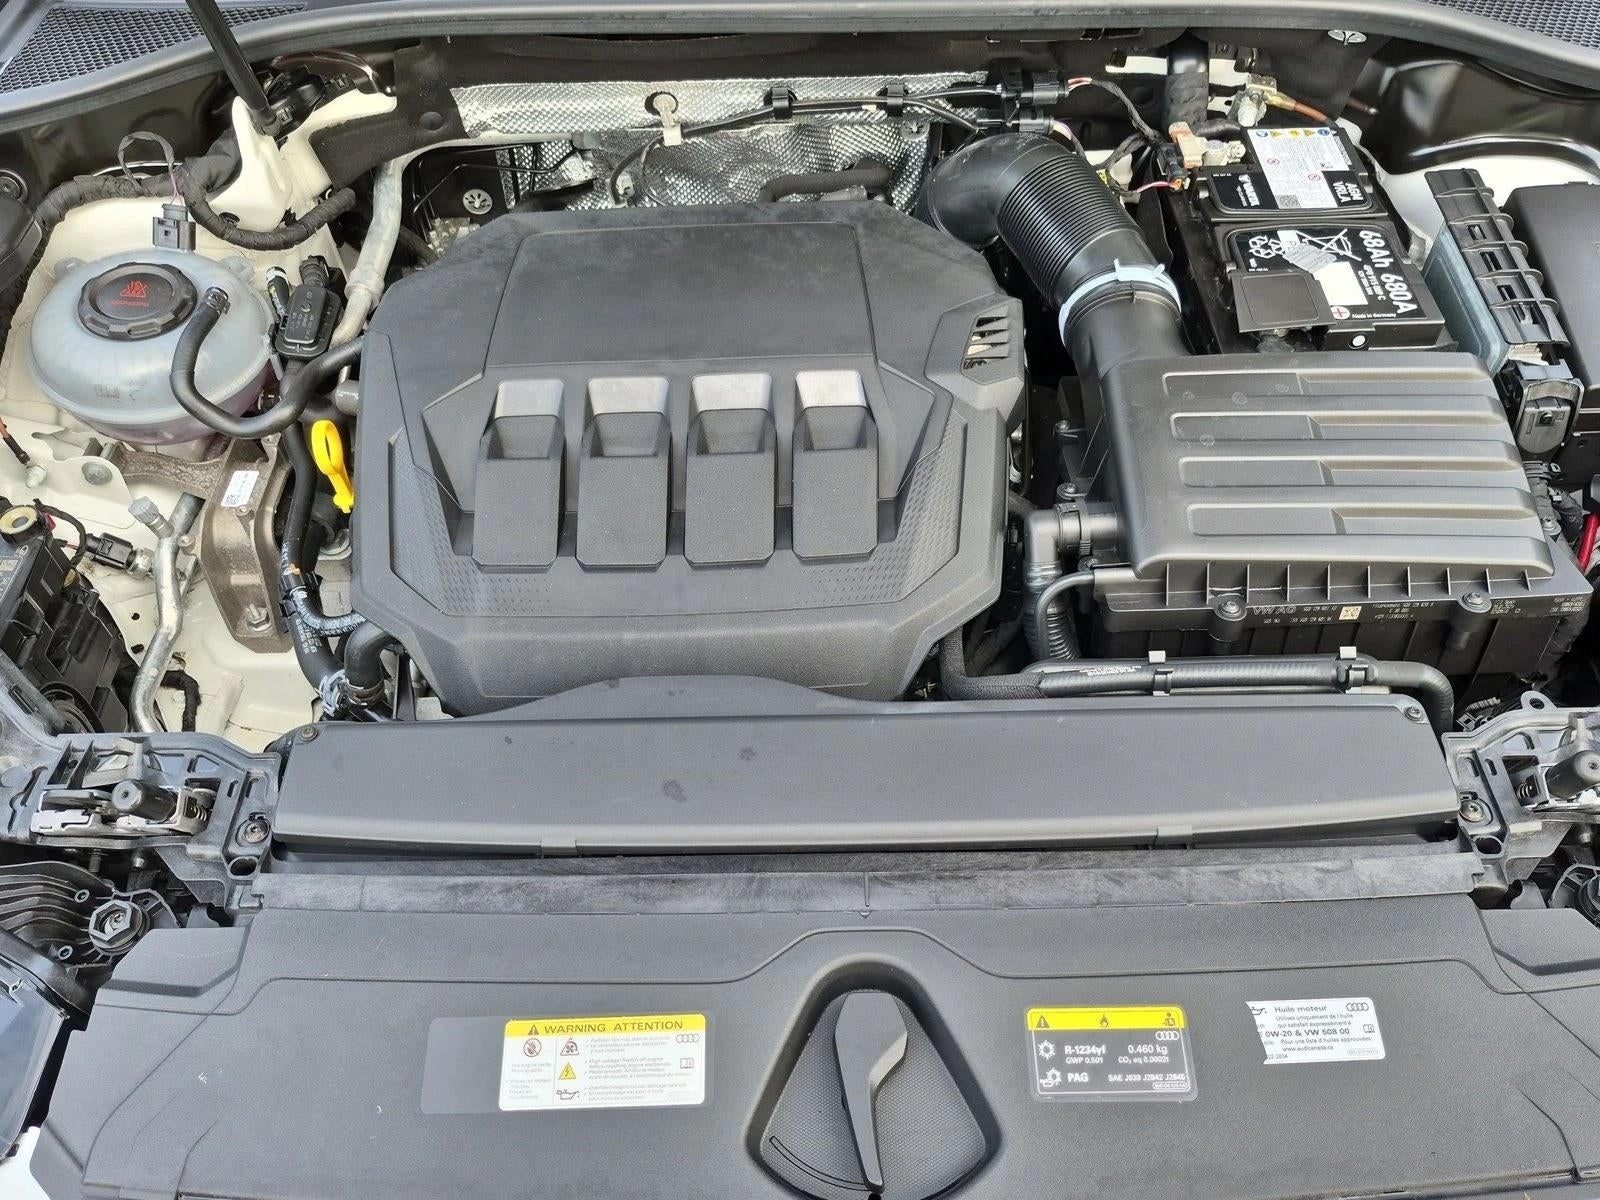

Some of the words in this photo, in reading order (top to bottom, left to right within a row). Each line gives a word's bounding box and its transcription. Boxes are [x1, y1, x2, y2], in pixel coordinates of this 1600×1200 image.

[1359, 230, 1394, 268] 68Ah
[1380, 273, 1418, 314] 680A
[1253, 606, 1275, 616] VW
[1276, 605, 1297, 614] AG
[544, 1024, 606, 1034] WARNING
[613, 1020, 683, 1032] ATTENTION
[1265, 1030, 1292, 1038] 0W-20
[1064, 1045, 1106, 1056] R-1234yf
[1128, 1044, 1153, 1054] 0.460
[1155, 1044, 1168, 1055] kg
[1085, 1056, 1104, 1064] 0.501
[1067, 1072, 1089, 1083] PAG
[1108, 1074, 1123, 1082] SAE
